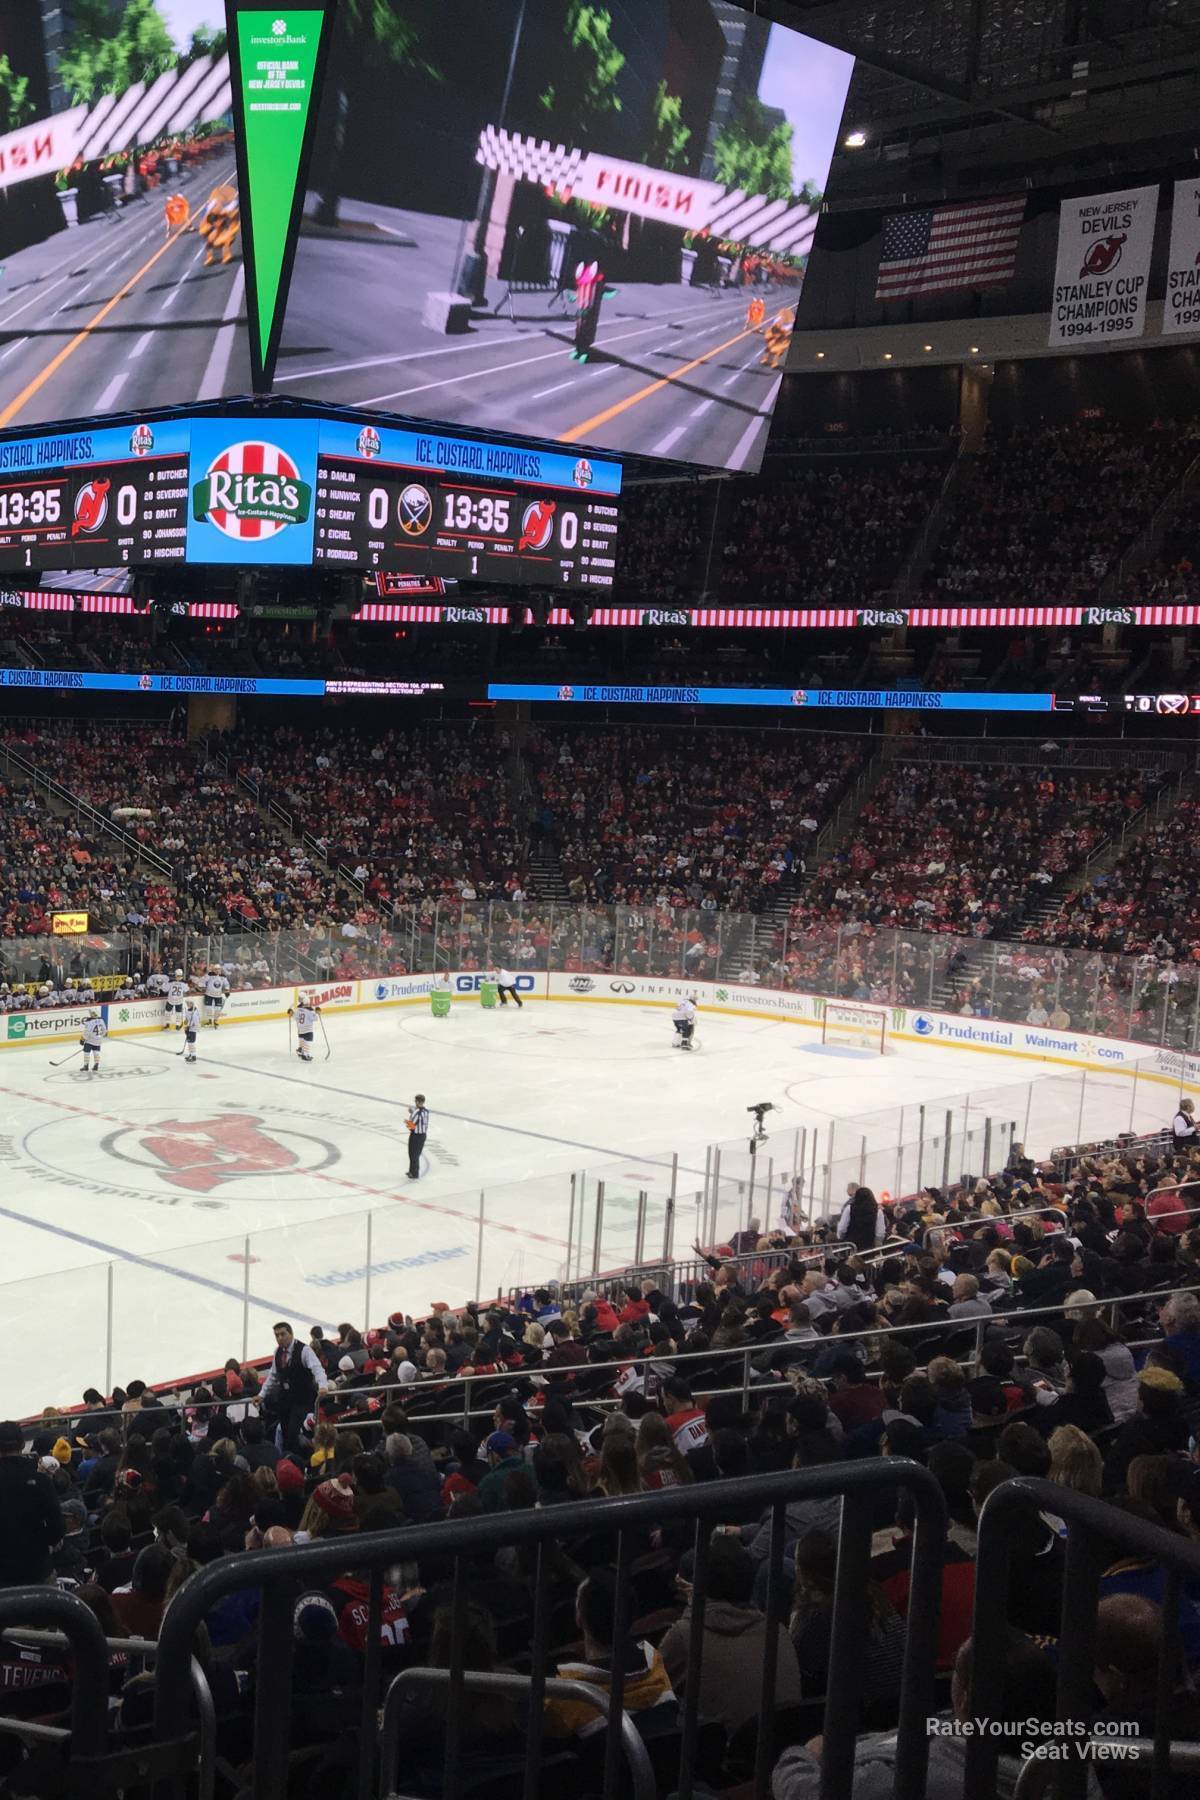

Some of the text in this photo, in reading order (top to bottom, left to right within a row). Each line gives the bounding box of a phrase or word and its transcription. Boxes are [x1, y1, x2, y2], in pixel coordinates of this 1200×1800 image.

[1079, 200, 1139, 218] NEW JERSEY
[1081, 214, 1133, 235] DEVILS
[1055, 275, 1145, 303] STANLEY CUP
[1057, 296, 1138, 322] CHAMPIONS
[1059, 316, 1134, 337] 1994-1995
[36, 436, 95, 465] HAPPINESS.
[415, 438, 543, 480] ICE. CUSTARD. HAPPINESS.
[157, 468, 188, 481] BUTCHER
[330, 470, 356, 483] DAHLIN
[156, 488, 188, 500] SEVERSON
[208, 471, 300, 512] Rita's
[330, 489, 361, 502] HUNWICK
[0, 488, 61, 527] 13:35
[116, 484, 137, 525] 0
[367, 487, 389, 529] 0
[444, 493, 510, 533] 13:35
[155, 509, 177, 519] BRATT
[329, 511, 356, 521] SHEARY
[154, 528, 187, 539] JOHANSSON
[559, 511, 578, 551] 0
[122, 549, 129, 561] 5
[372, 553, 379, 565] 5
[446, 606, 484, 623] Rita's
[649, 608, 687, 626] Rita's
[862, 609, 904, 626] Rita's
[1088, 606, 1132, 624] Rita's
[8, 671, 43, 685] CUSTARD.
[44, 672, 84, 687] HAPPINESS.
[160, 677, 175, 690] ICE.
[176, 677, 213, 691] CUSTARD.
[214, 678, 258, 692] HAPPINESS.
[583, 687, 598, 700] ICE.
[600, 688, 644, 701] CUSTARD.
[646, 689, 700, 703] HAPPINESS.
[817, 690, 834, 704] ICE.
[836, 691, 884, 707] CUSTARD.
[884, 692, 944, 708] HAPPINESS.
[171, 986, 182, 996] 26
[391, 983, 435, 996] Prudentia
[569, 978, 594, 988] NHL
[641, 984, 706, 997] INFINITI
[731, 993, 804, 1011] investorsBank
[13, 1011, 88, 1032] enterprise
[938, 1021, 1013, 1047] Prudential
[1025, 1033, 1124, 1061] Walmart com
[305, 1244, 471, 1290] ticketmaster
